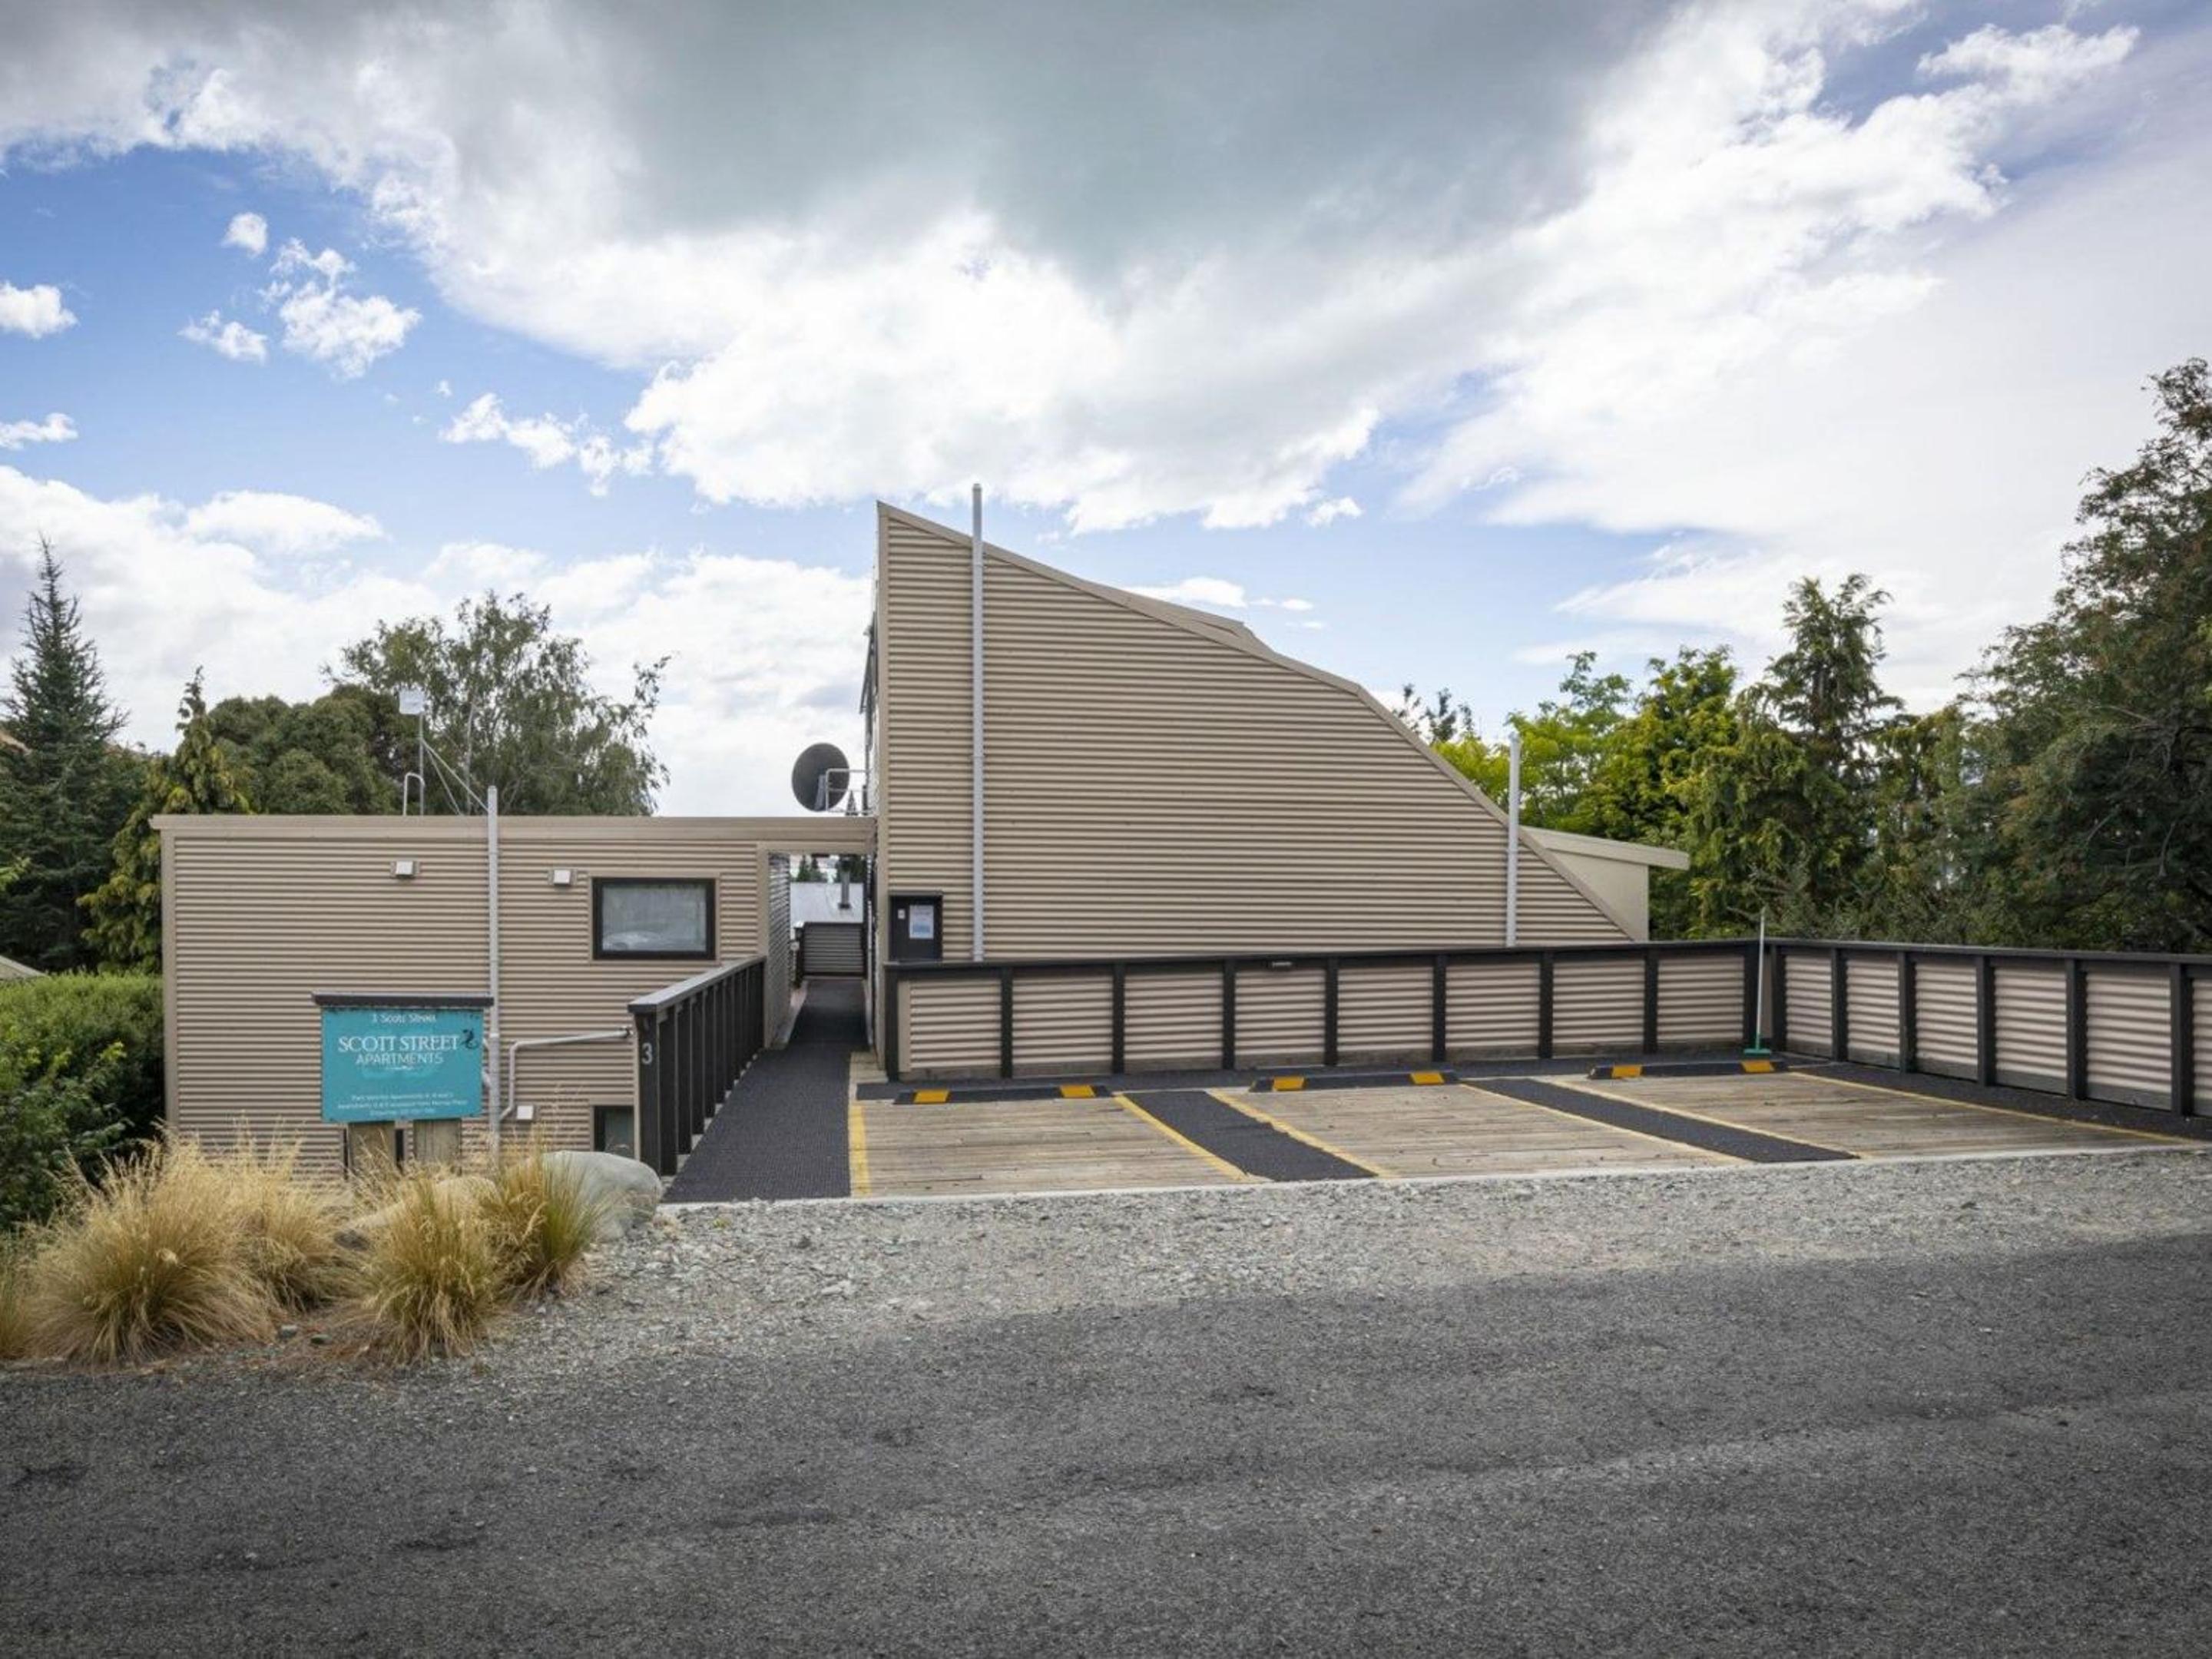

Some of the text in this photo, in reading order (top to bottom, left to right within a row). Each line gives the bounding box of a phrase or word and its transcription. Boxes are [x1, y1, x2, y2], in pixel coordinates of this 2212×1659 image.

[379, 1013, 406, 1023] Scott
[338, 1034, 460, 1052] SCOTT STREET
[355, 1051, 444, 1065] APARTMENTS
[641, 1042, 653, 1065] 3
